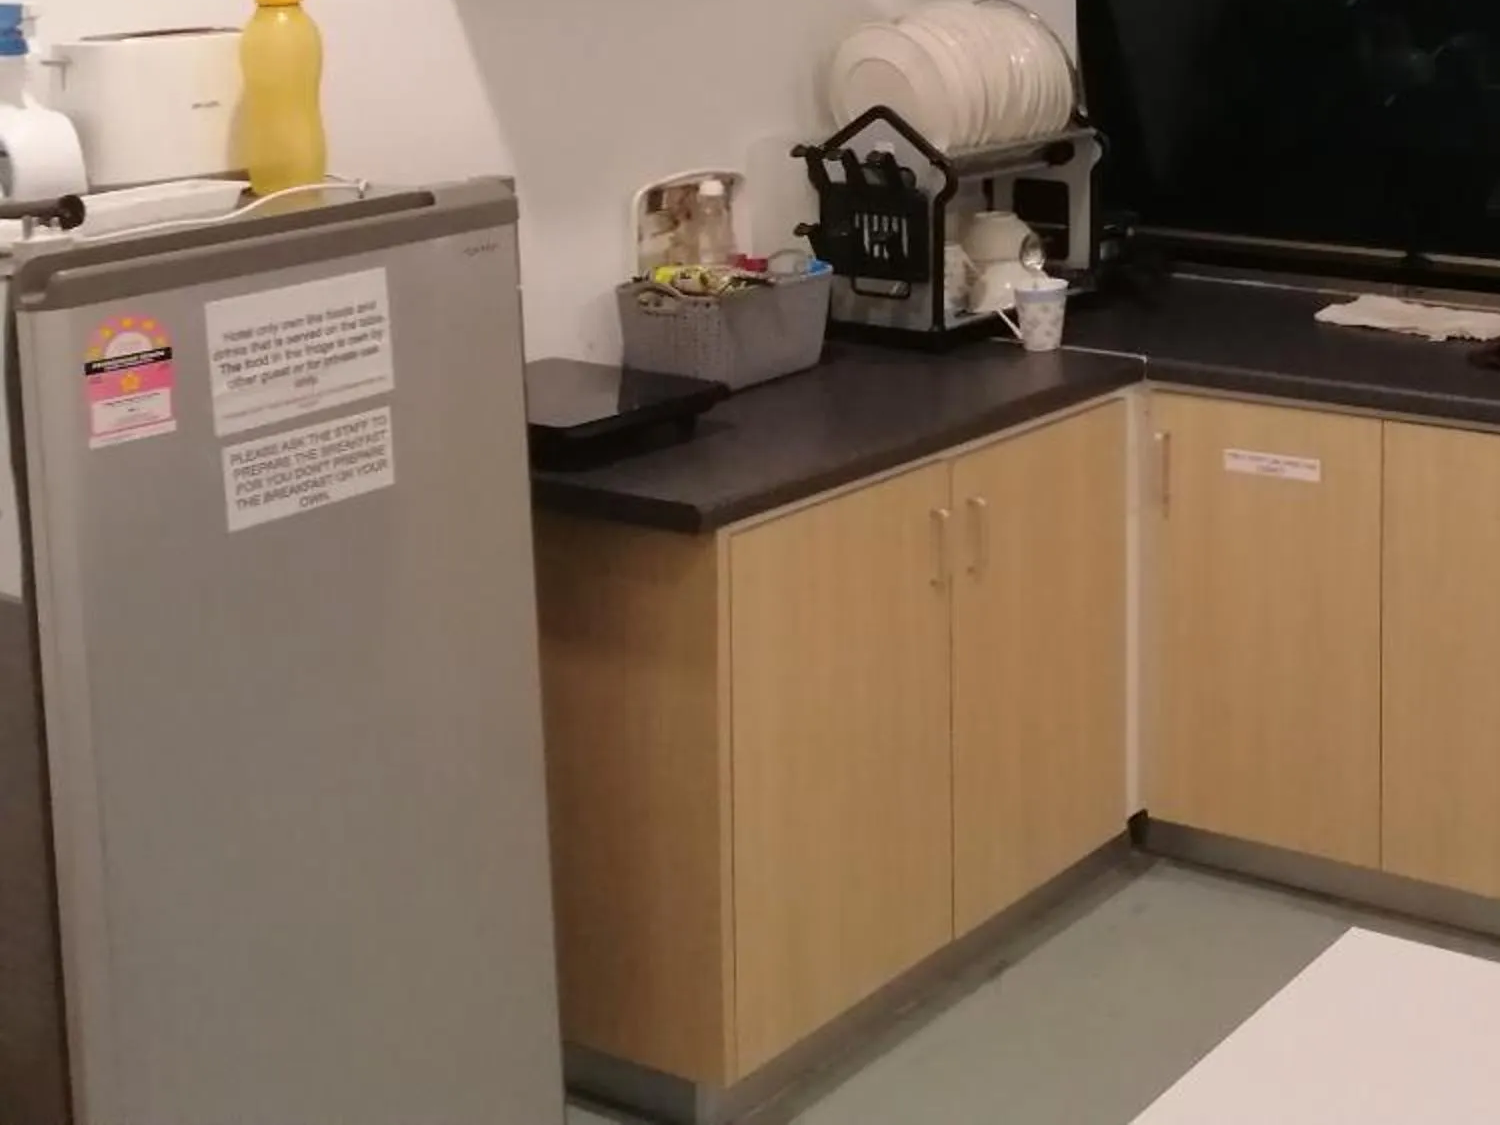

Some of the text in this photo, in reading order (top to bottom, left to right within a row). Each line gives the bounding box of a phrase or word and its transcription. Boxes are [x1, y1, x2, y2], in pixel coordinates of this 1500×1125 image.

[218, 361, 242, 375] The
[244, 354, 269, 369] food
[230, 414, 387, 465] PLEASE ASK THE STAFF TO
[232, 428, 388, 480] PREPARE THE BREAKFAST
[235, 493, 262, 512] THE
[262, 472, 333, 505] BREAKFAST
[355, 457, 389, 477] YOUR
[236, 478, 263, 496] FOR
[264, 470, 293, 487] YOU
[332, 443, 386, 470] PREPARE
